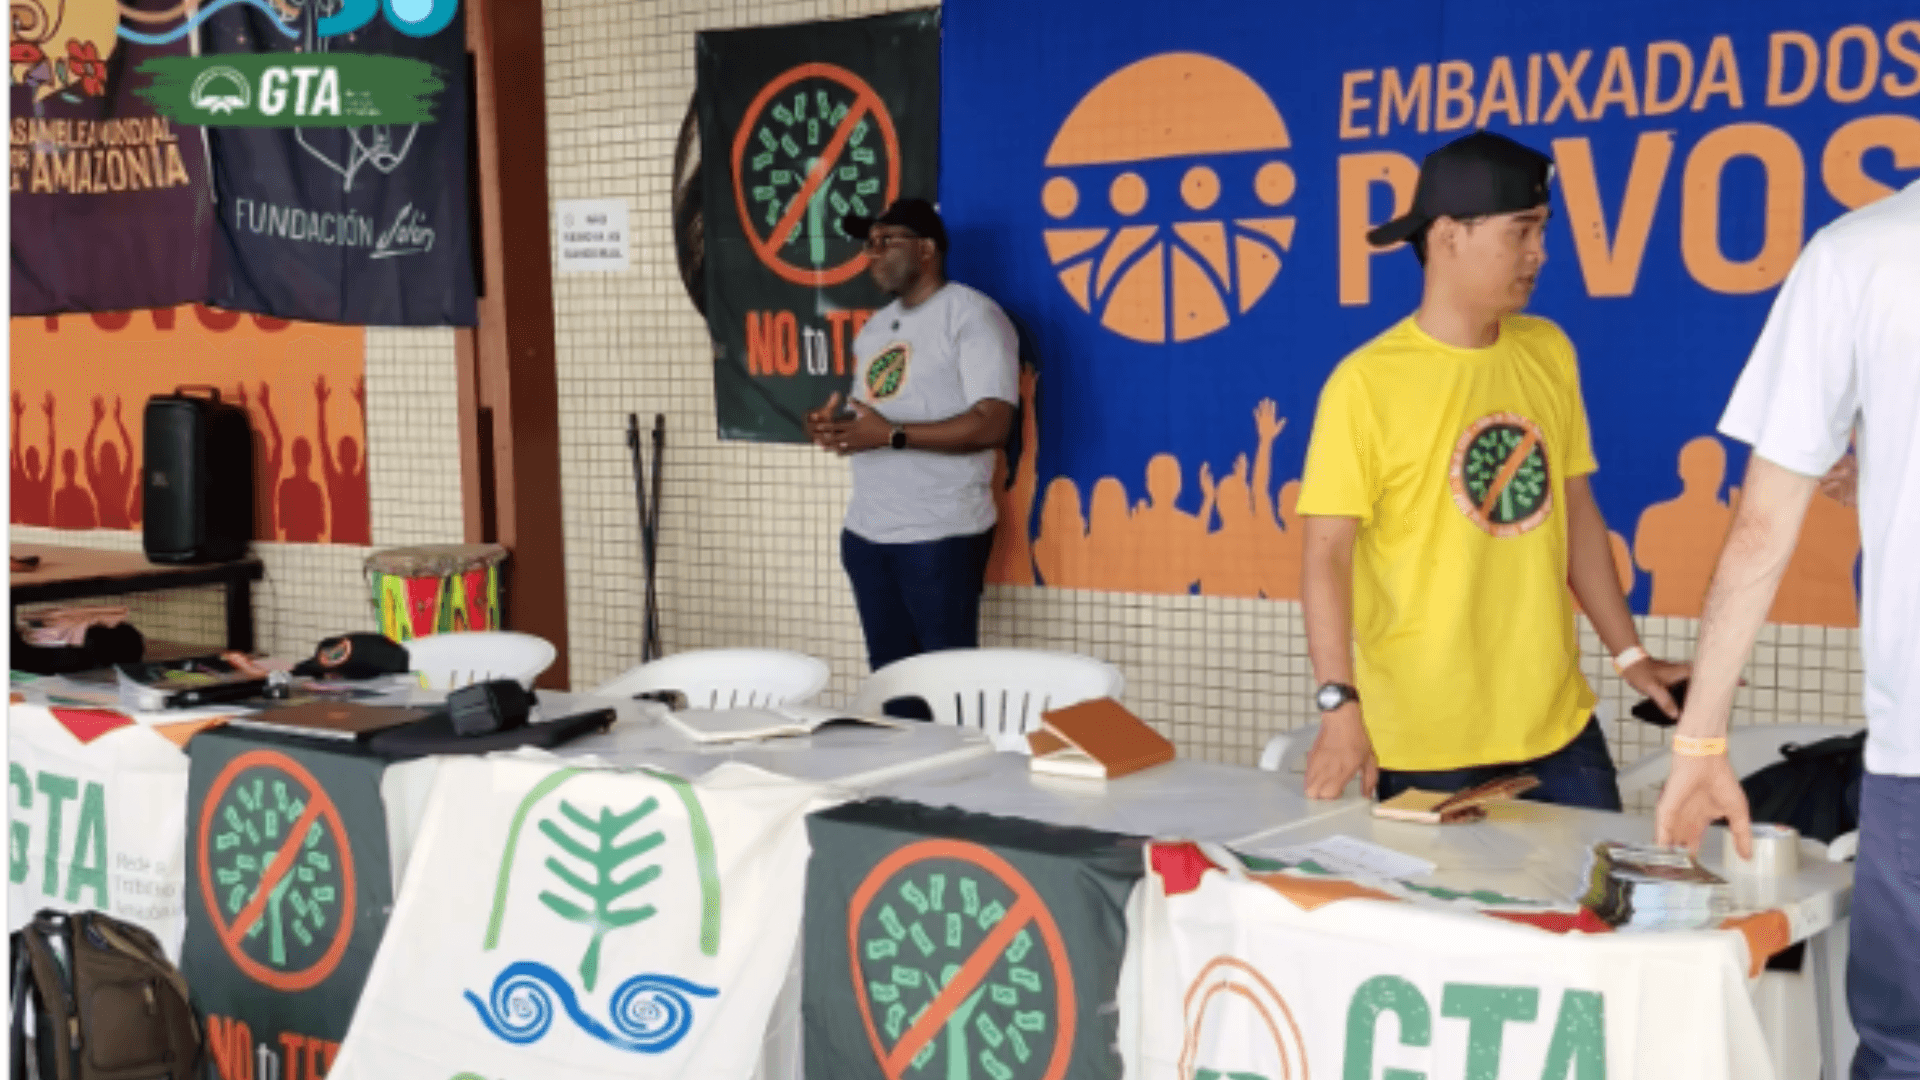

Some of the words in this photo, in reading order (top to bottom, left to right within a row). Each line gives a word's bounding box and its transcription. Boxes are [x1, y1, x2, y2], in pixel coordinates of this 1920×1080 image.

[1339, 34, 1744, 140] EMBAIXADA
[1765, 20, 1920, 107] DOS
[233, 197, 374, 246] FUNDACIÓN
[1338, 114, 1920, 306] PVO
[745, 310, 799, 375] NO
